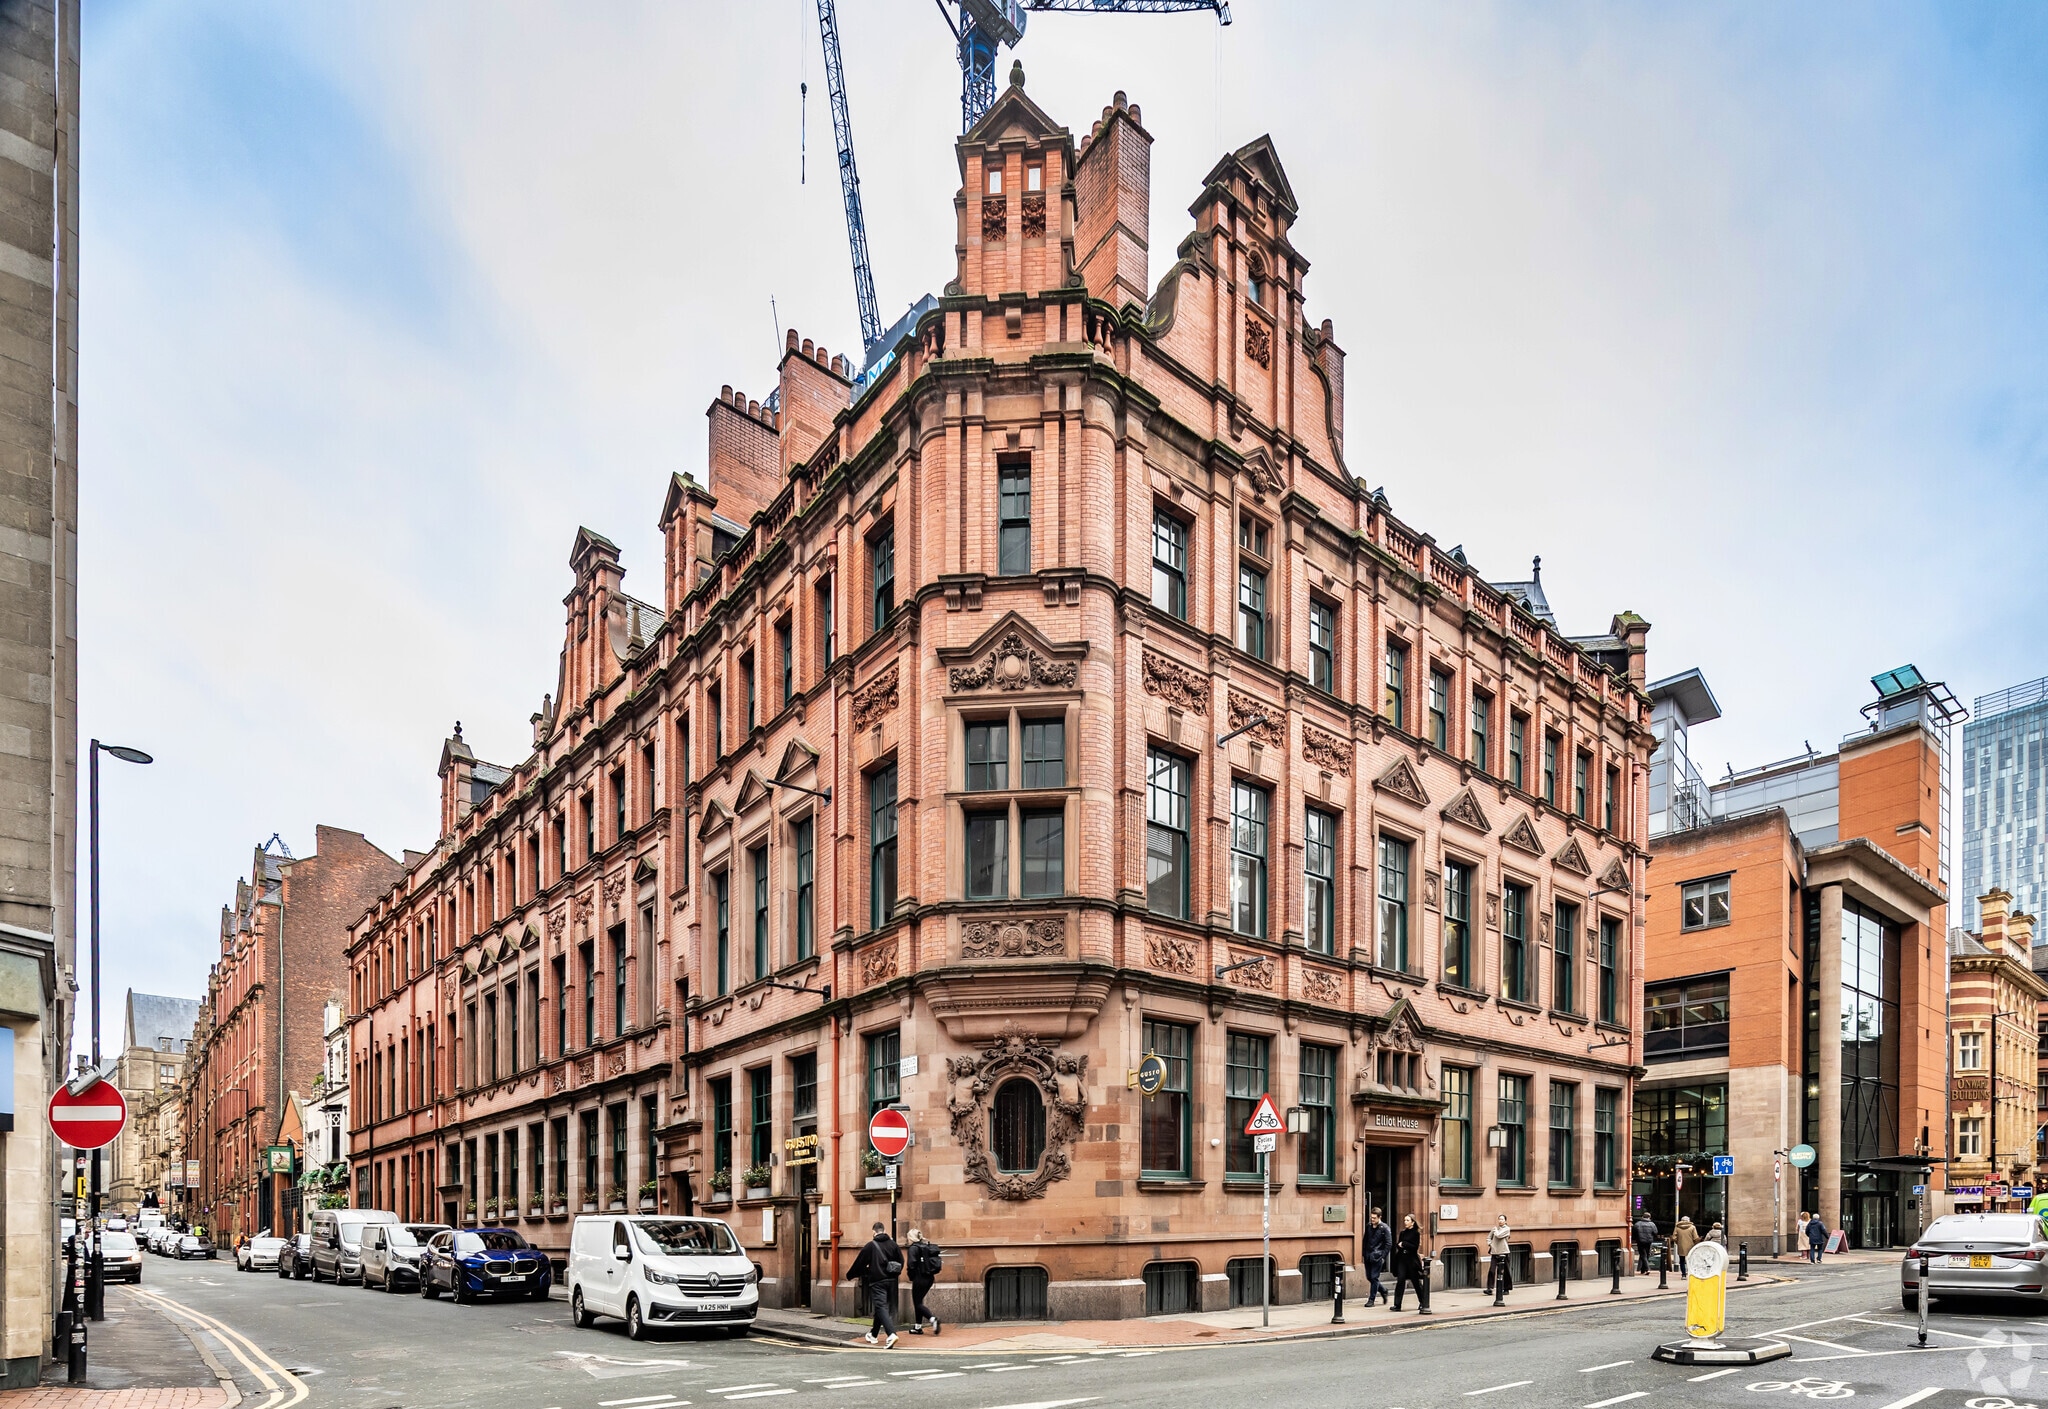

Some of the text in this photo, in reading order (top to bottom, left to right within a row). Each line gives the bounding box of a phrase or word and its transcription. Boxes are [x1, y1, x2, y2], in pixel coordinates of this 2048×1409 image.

[901, 1057, 916, 1068] LLOYD
[901, 1065, 916, 1076] STREET
[1140, 1069, 1160, 1078] GUSTO
[1376, 1114, 1418, 1128] Elliot House
[785, 1134, 818, 1150] GUSTO
[1955, 1187, 1983, 1195] OPKAPI
